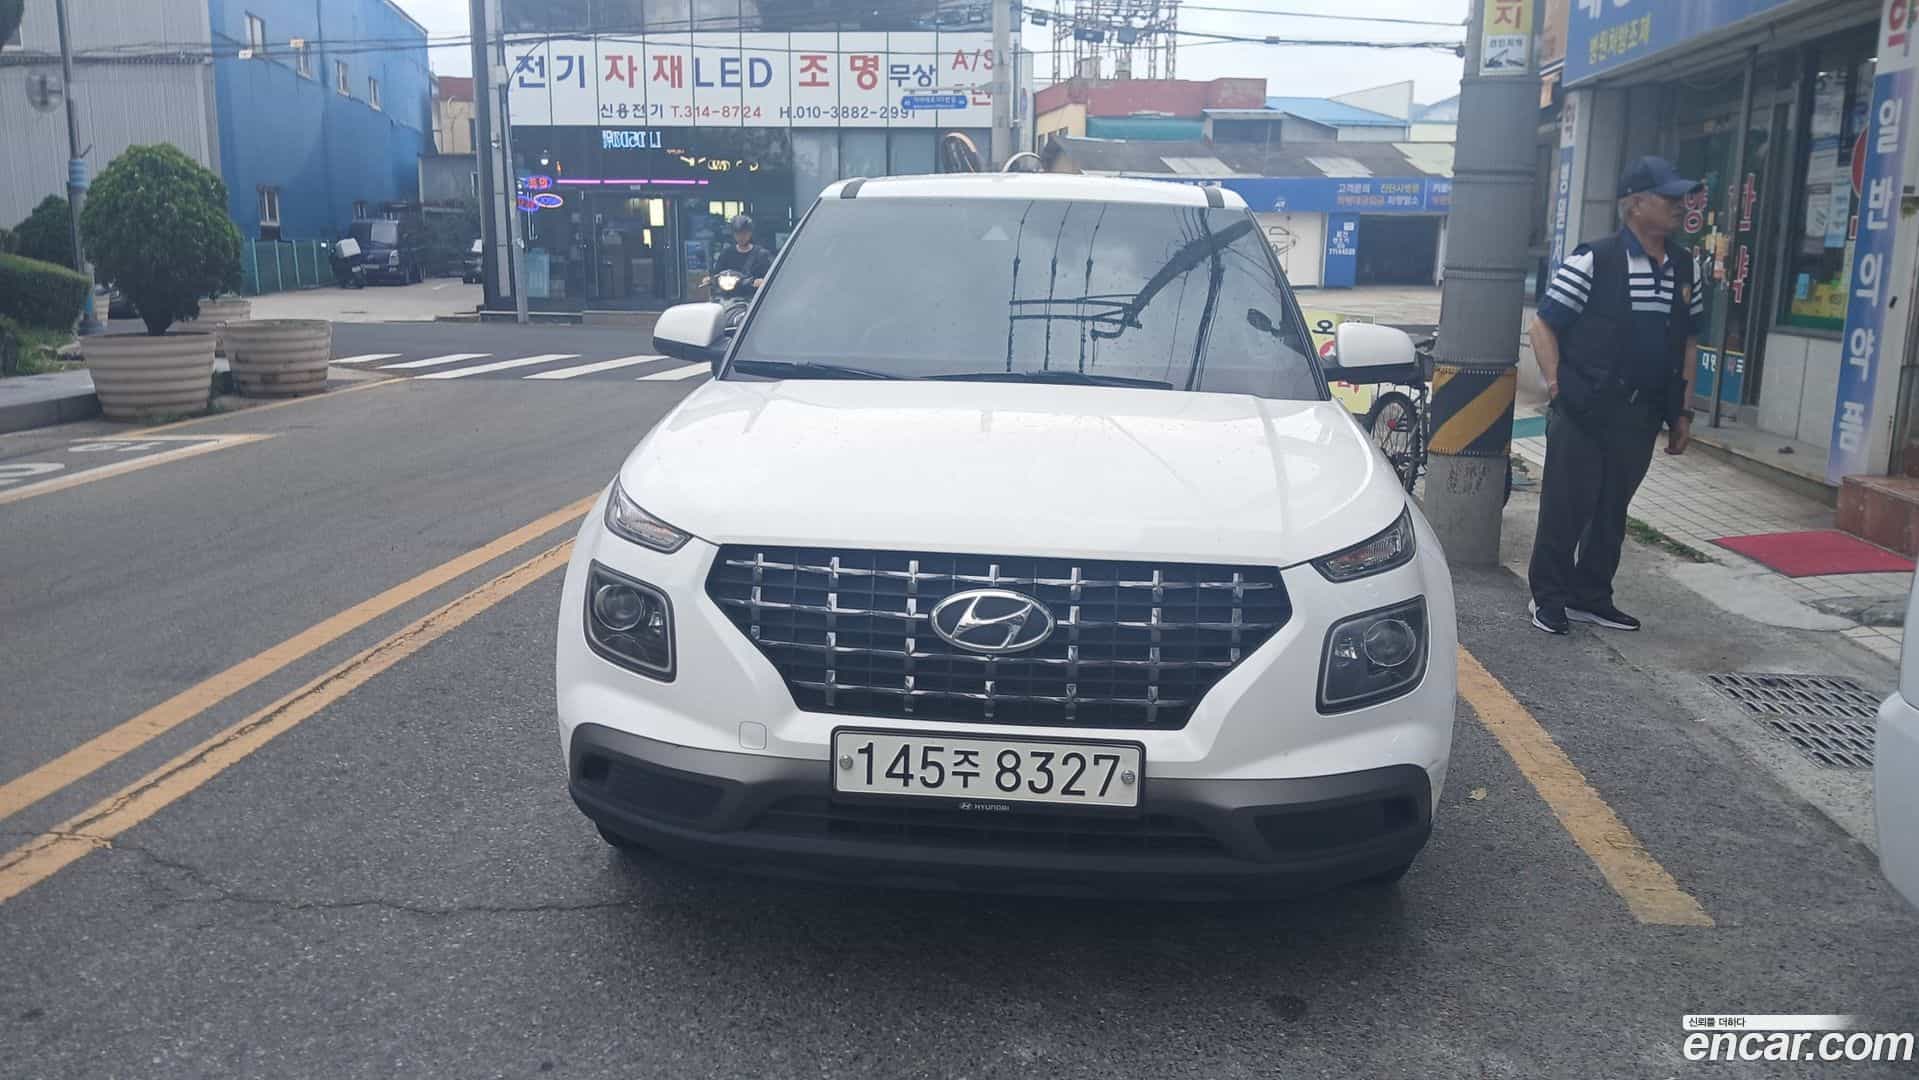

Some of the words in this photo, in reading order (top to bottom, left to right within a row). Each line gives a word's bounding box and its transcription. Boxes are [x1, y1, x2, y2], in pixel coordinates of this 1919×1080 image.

[604, 55, 683, 89] 자재
[694, 56, 773, 89] LED
[889, 64, 937, 88] 무상
[952, 49, 993, 72] A/S
[600, 103, 664, 119] 신용전기
[1838, 97, 1902, 453] 일반의약품
[857, 742, 980, 789] 145주
[995, 749, 1121, 798] 8327
